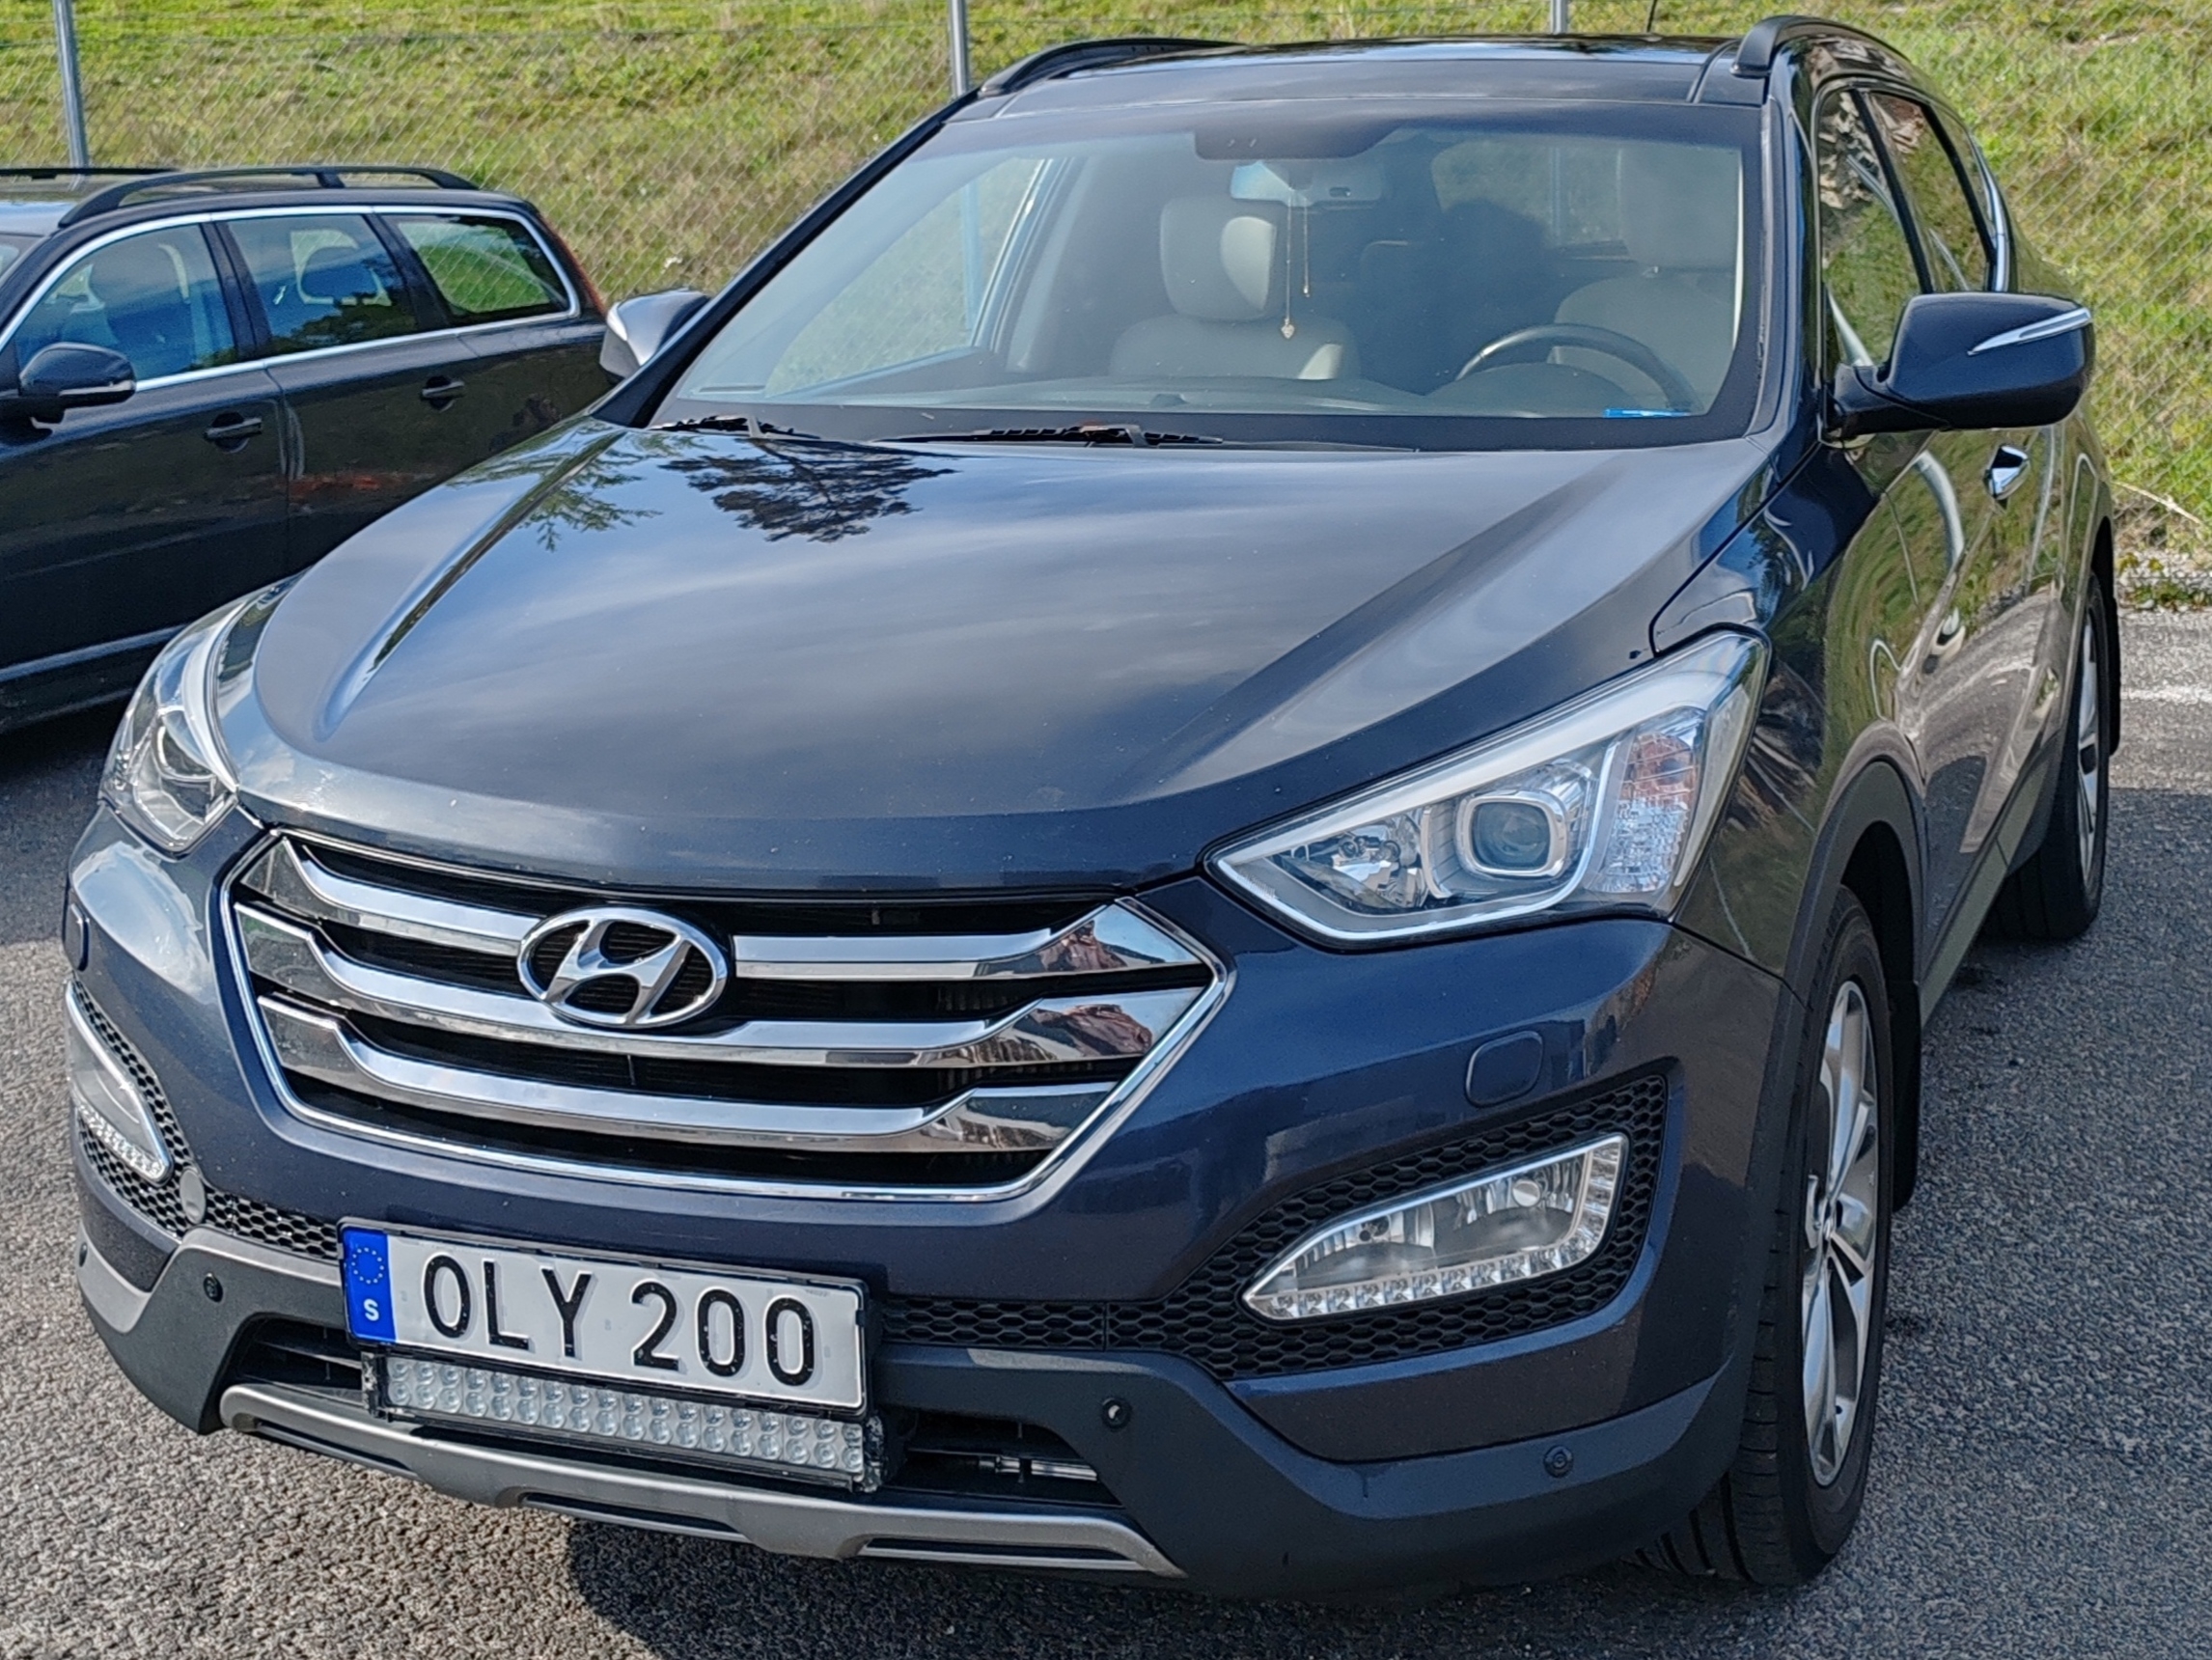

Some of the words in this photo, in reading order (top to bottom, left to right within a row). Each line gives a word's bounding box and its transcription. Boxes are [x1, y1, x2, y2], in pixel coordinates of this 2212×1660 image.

[363, 1298, 380, 1322] S
[423, 1255, 593, 1357] OLY
[631, 1281, 816, 1387] 200
